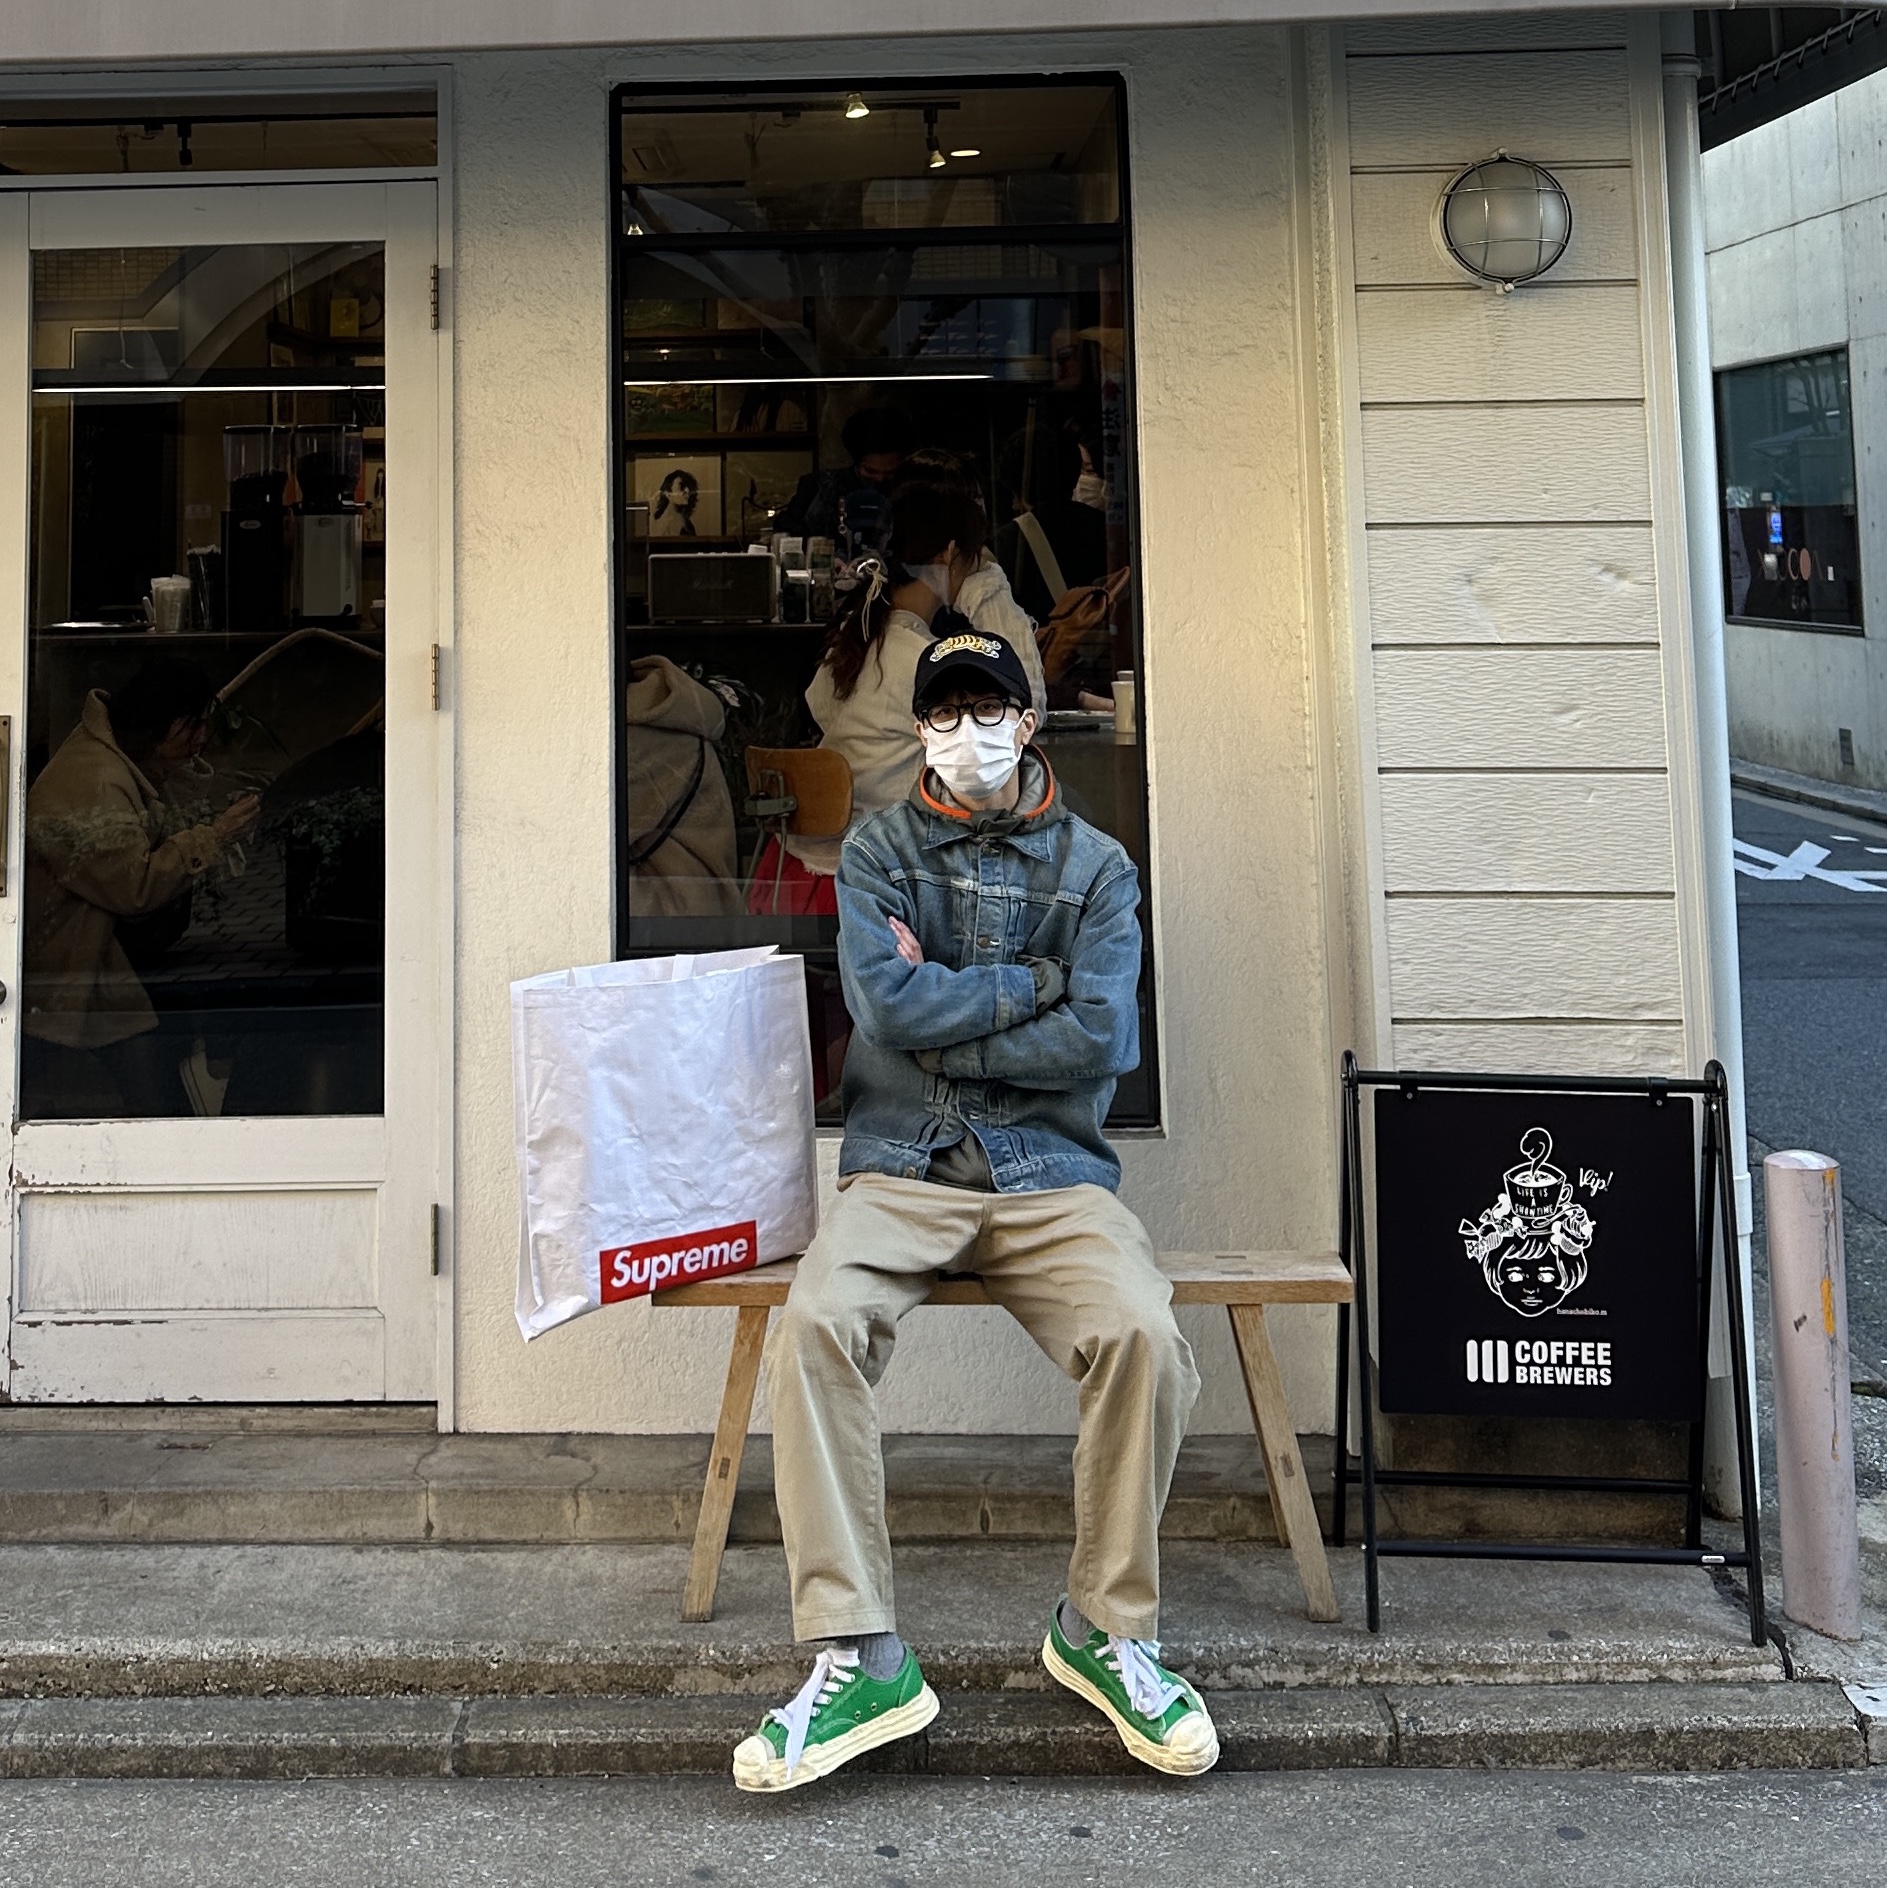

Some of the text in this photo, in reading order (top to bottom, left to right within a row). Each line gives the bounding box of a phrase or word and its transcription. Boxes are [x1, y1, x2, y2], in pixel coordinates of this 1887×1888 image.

[1516, 1186, 1548, 1198] LIFE IS
[1531, 1197, 1536, 1207] A
[610, 1237, 749, 1291] Supreme
[1515, 1340, 1612, 1366] COFFEE
[1515, 1366, 1612, 1386] BREWERS
